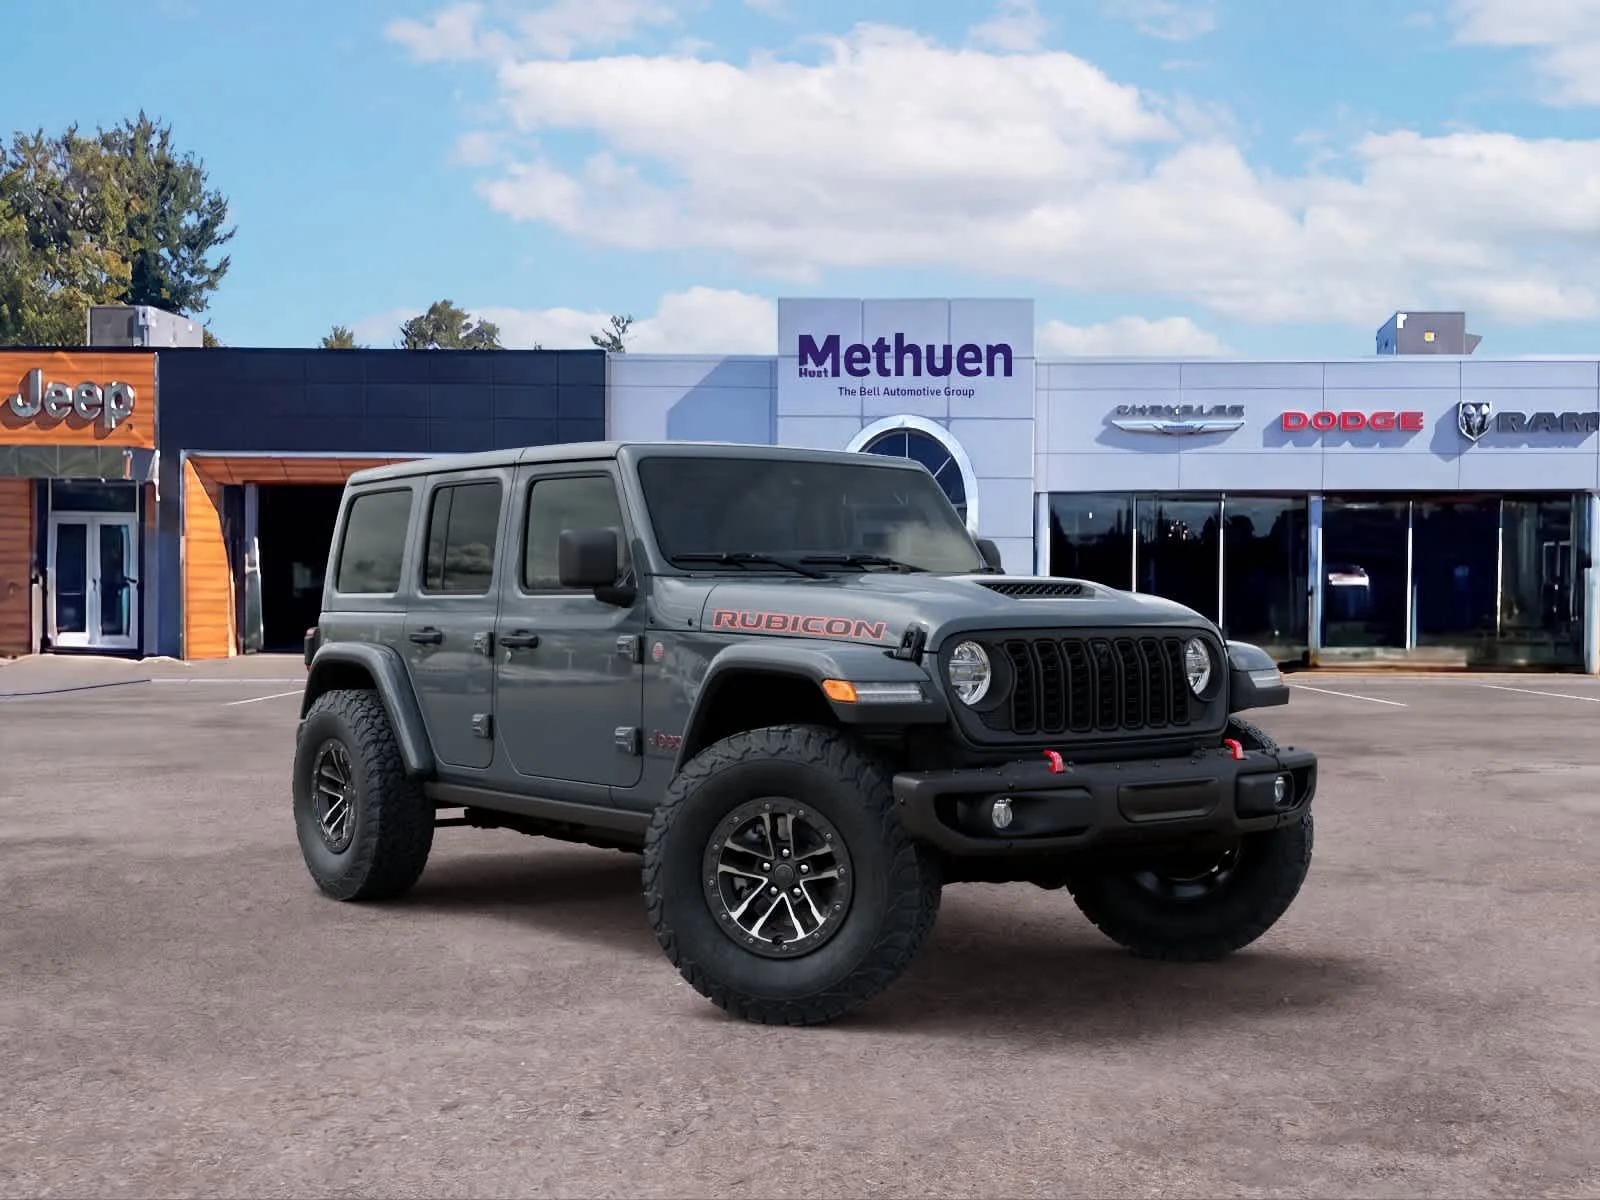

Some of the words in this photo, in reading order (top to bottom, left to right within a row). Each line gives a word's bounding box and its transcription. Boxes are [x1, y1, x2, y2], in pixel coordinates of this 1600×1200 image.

[799, 333, 1013, 377] Methuen
[9, 368, 136, 429] Jeep
[838, 387, 857, 397] The
[860, 387, 880, 397] Bell
[883, 387, 941, 397] Automotive
[944, 387, 975, 399] Group
[1282, 411, 1424, 432] DODGE
[1497, 411, 1600, 433] RAM
[712, 608, 888, 641] RUBICON
